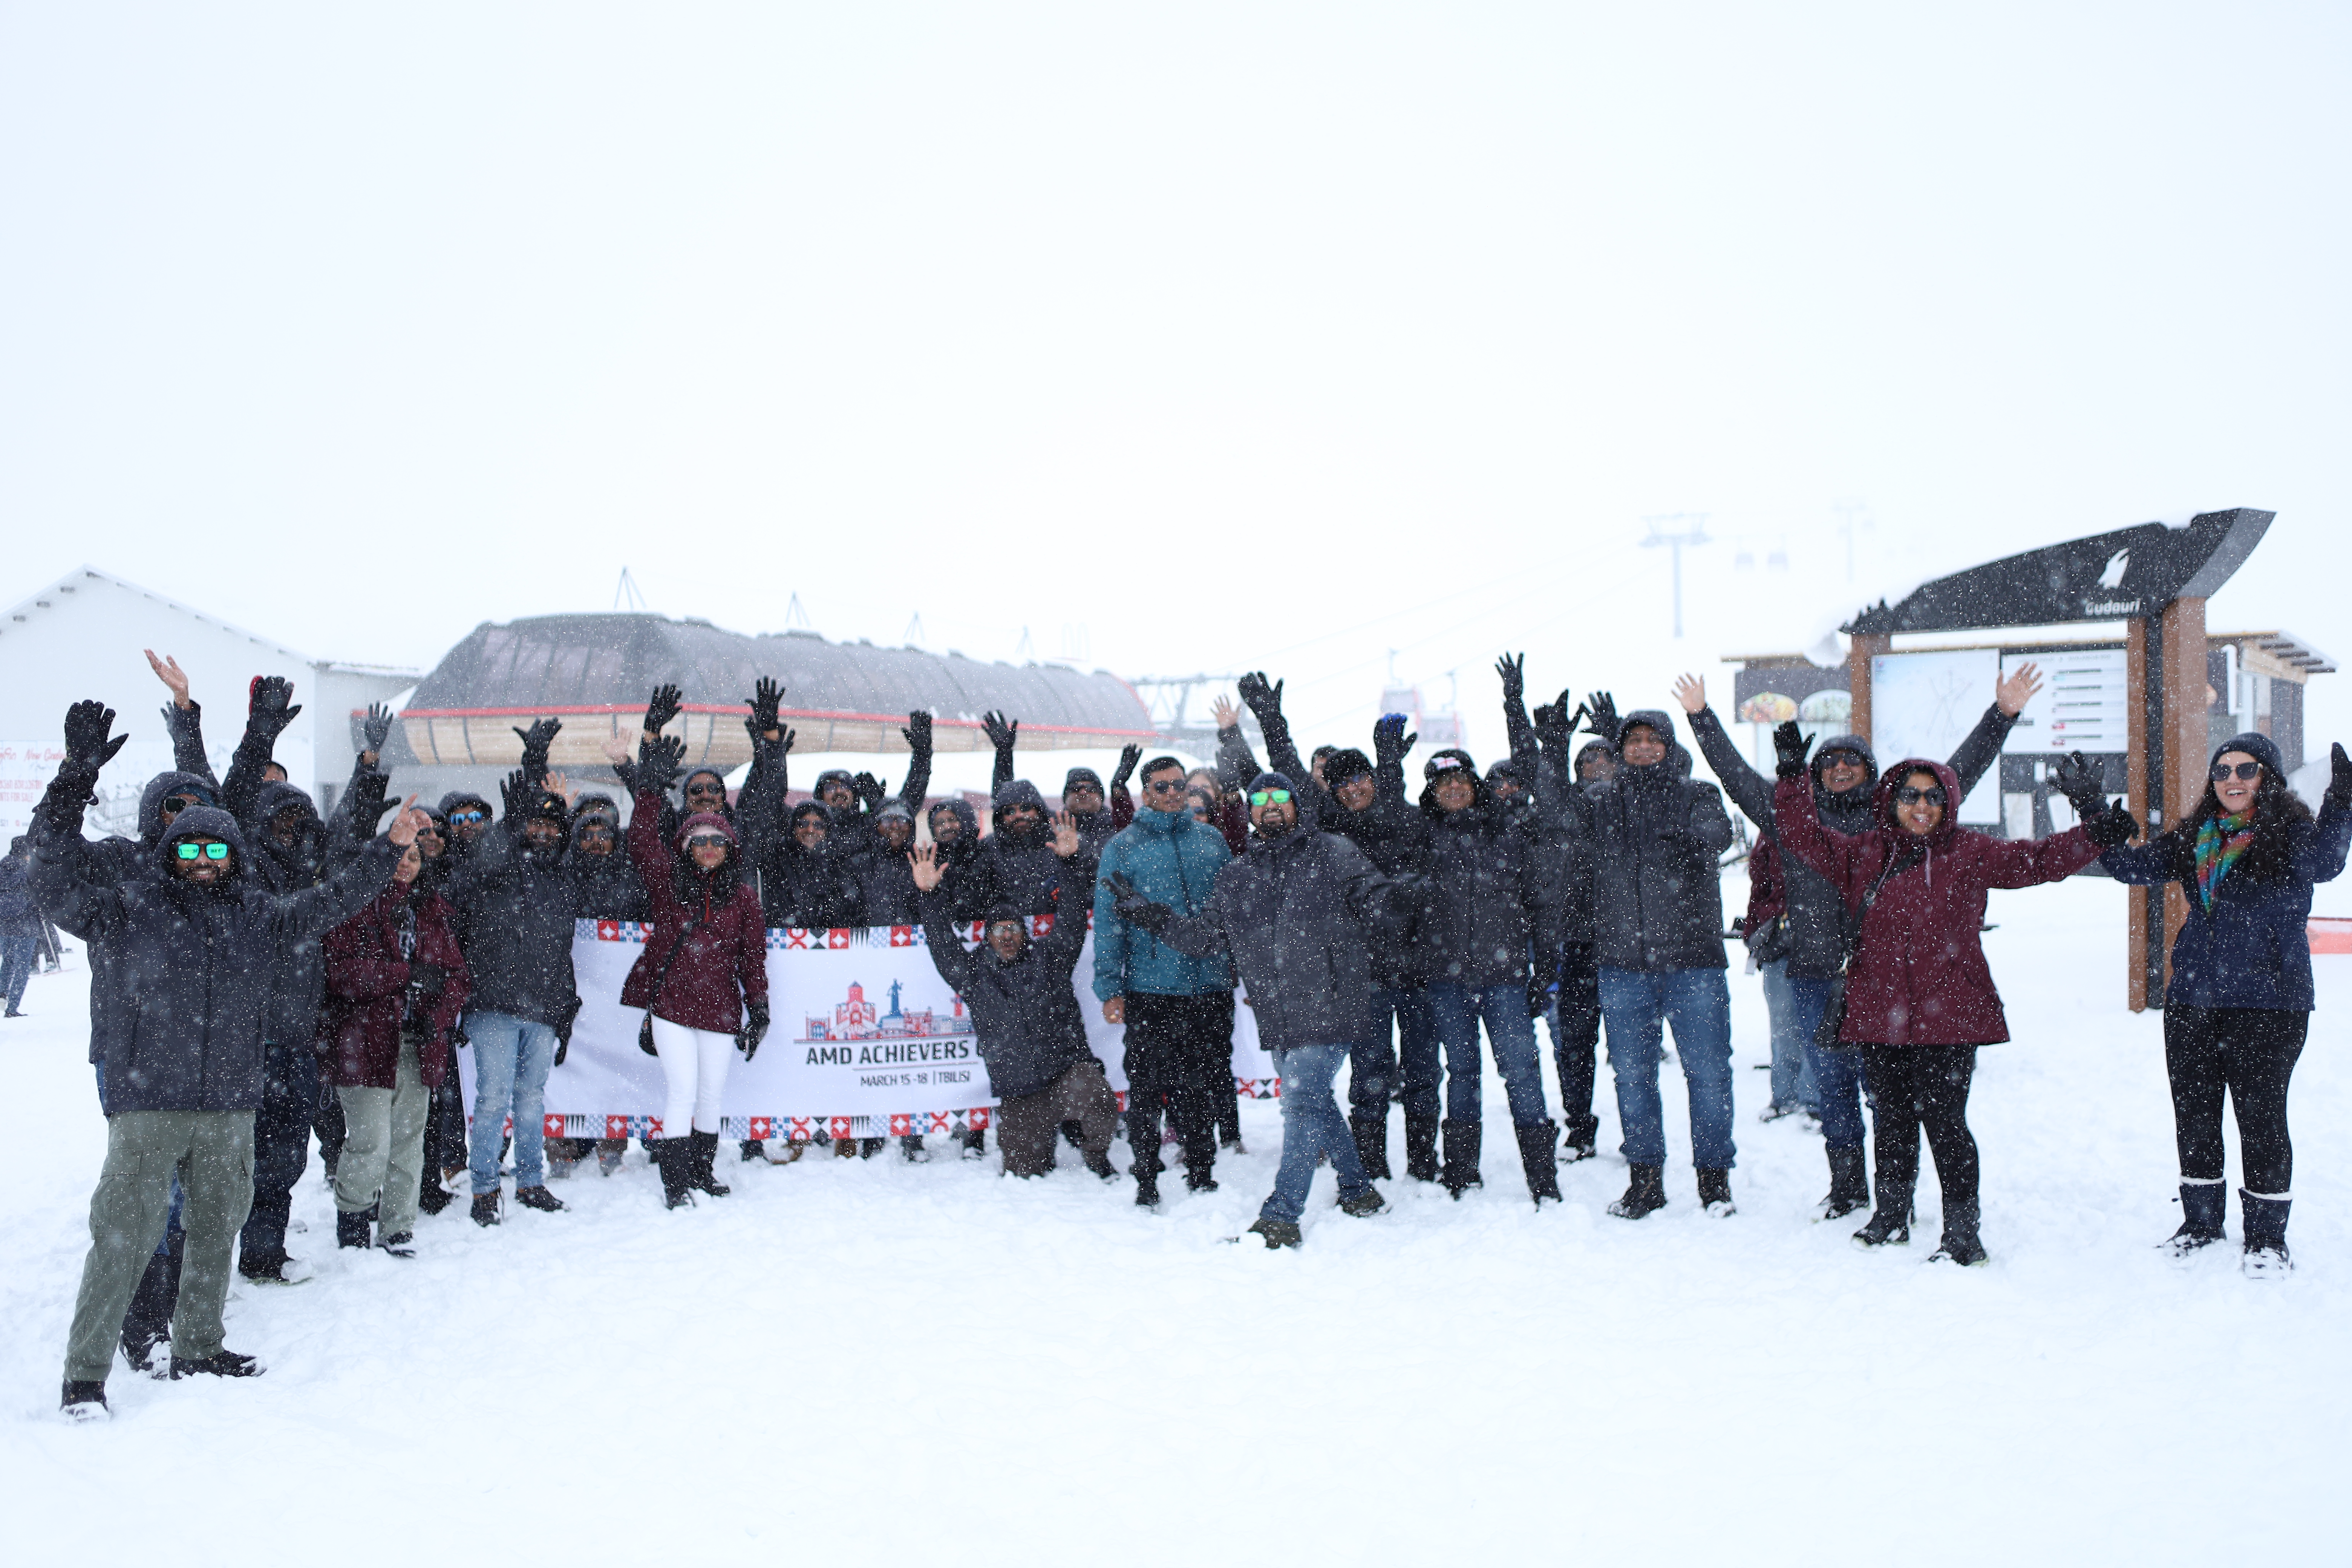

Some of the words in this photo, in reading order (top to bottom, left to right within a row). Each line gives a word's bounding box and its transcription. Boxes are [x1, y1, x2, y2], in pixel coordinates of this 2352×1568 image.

[2085, 597, 2141, 616] Gudauri
[21, 792, 34, 802] SALE
[805, 1046, 852, 1064] AMD
[858, 1040, 968, 1064] ACHIEVERS
[860, 1073, 897, 1087] MARCH
[900, 1073, 911, 1085] 15
[938, 1070, 971, 1083] TBILISI
